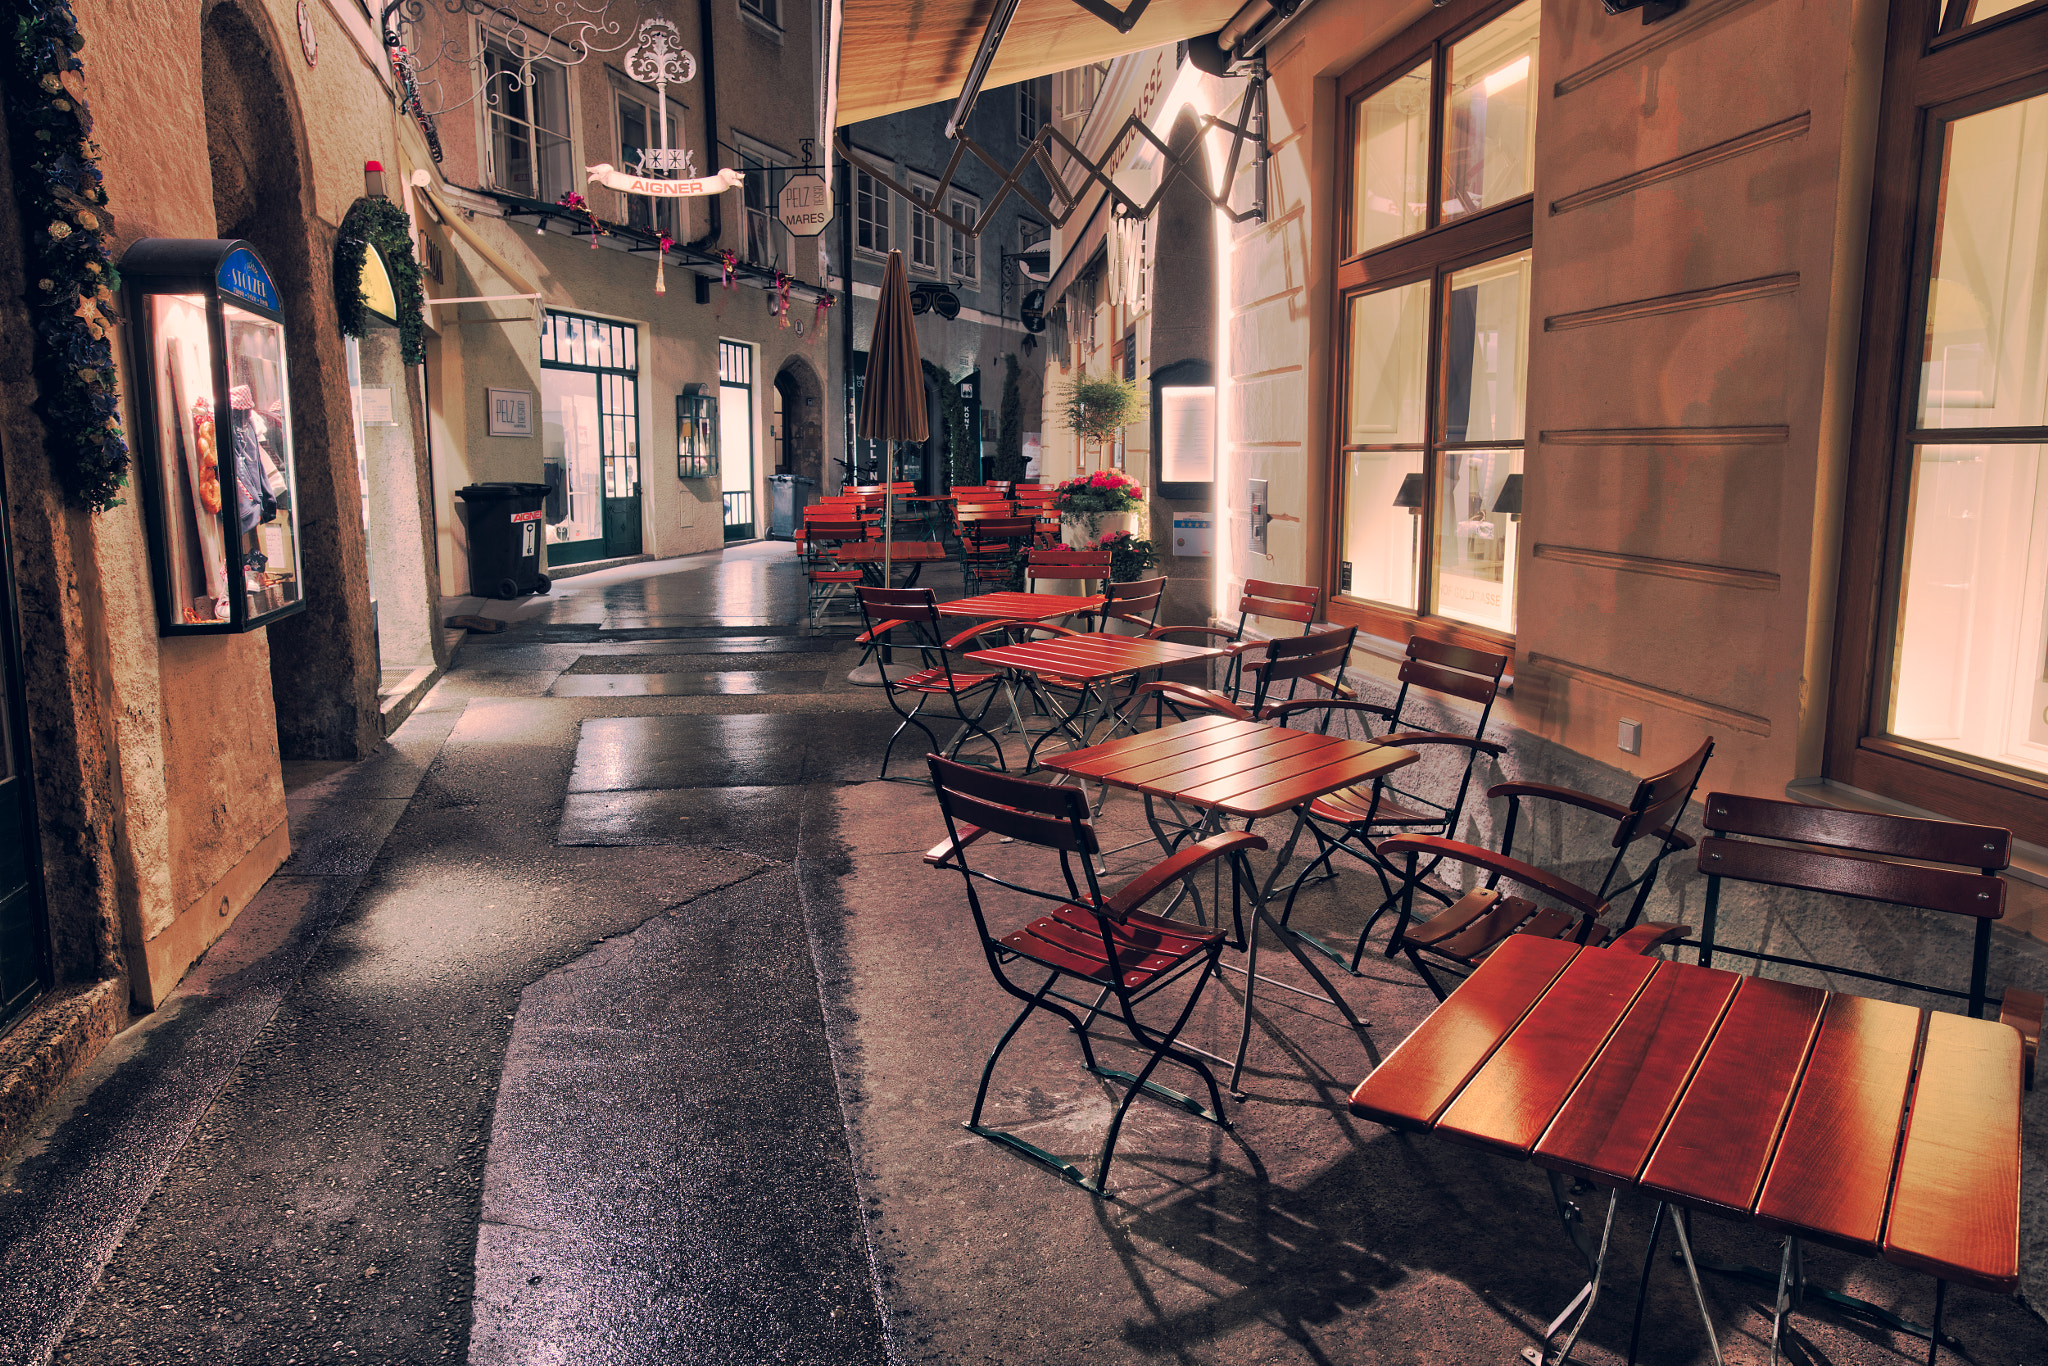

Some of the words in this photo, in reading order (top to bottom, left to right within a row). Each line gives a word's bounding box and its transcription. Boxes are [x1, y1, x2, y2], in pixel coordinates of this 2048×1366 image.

[631, 180, 703, 194] AIGNER
[785, 187, 810, 208] PELZ
[786, 212, 825, 226] MARES
[496, 399, 515, 423] PELZ
